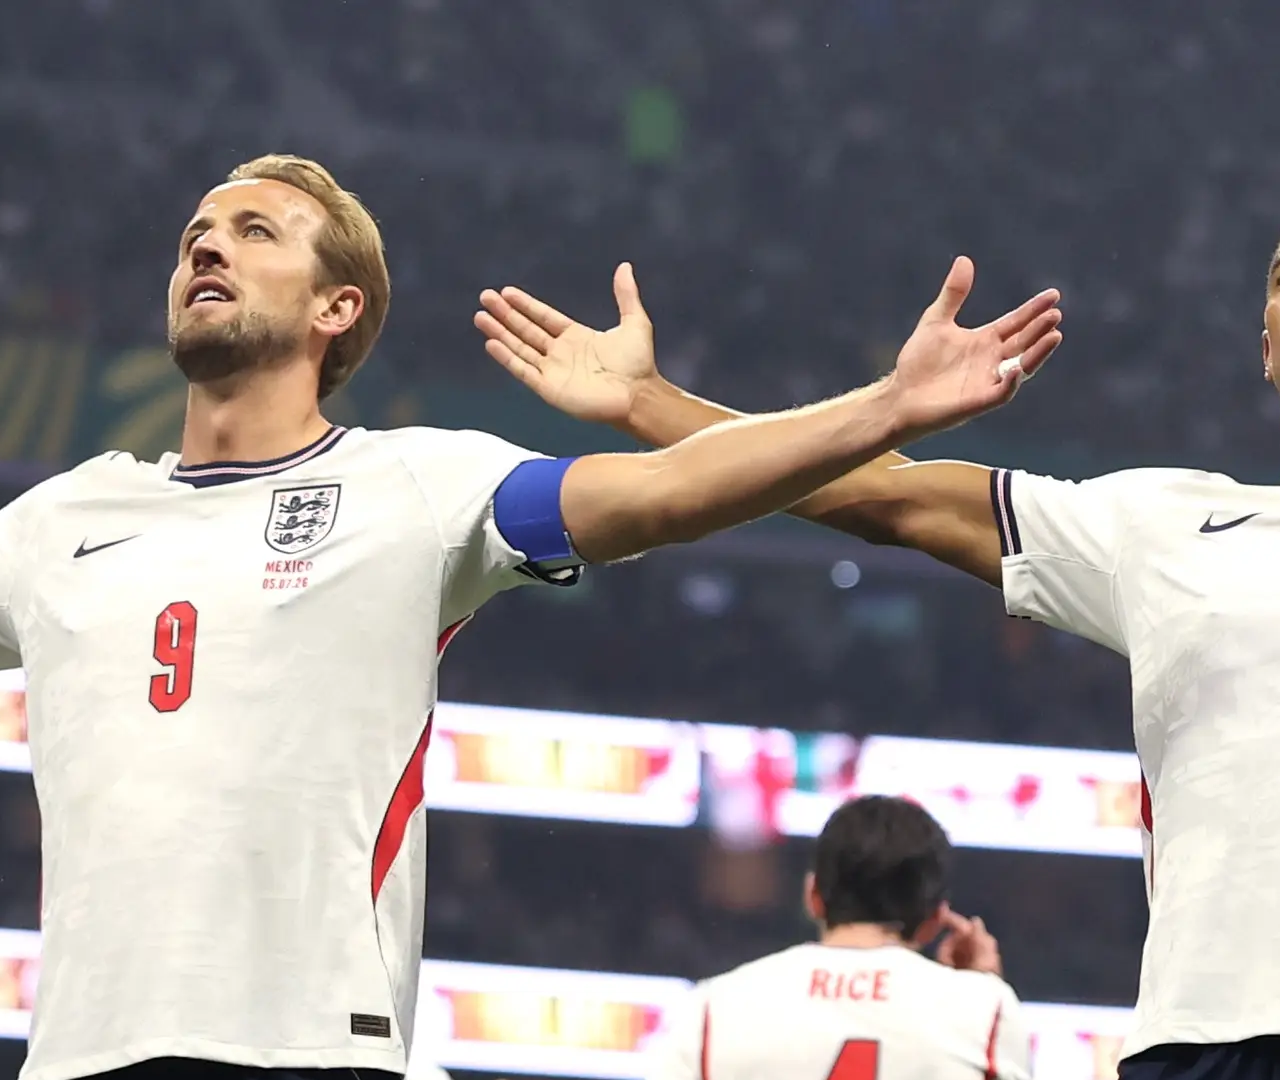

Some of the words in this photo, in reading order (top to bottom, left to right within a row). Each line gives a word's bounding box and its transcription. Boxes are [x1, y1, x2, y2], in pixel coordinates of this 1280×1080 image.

[265, 560, 313, 573] MEXICO
[149, 600, 198, 713] 9
[808, 968, 890, 1001] RICE
